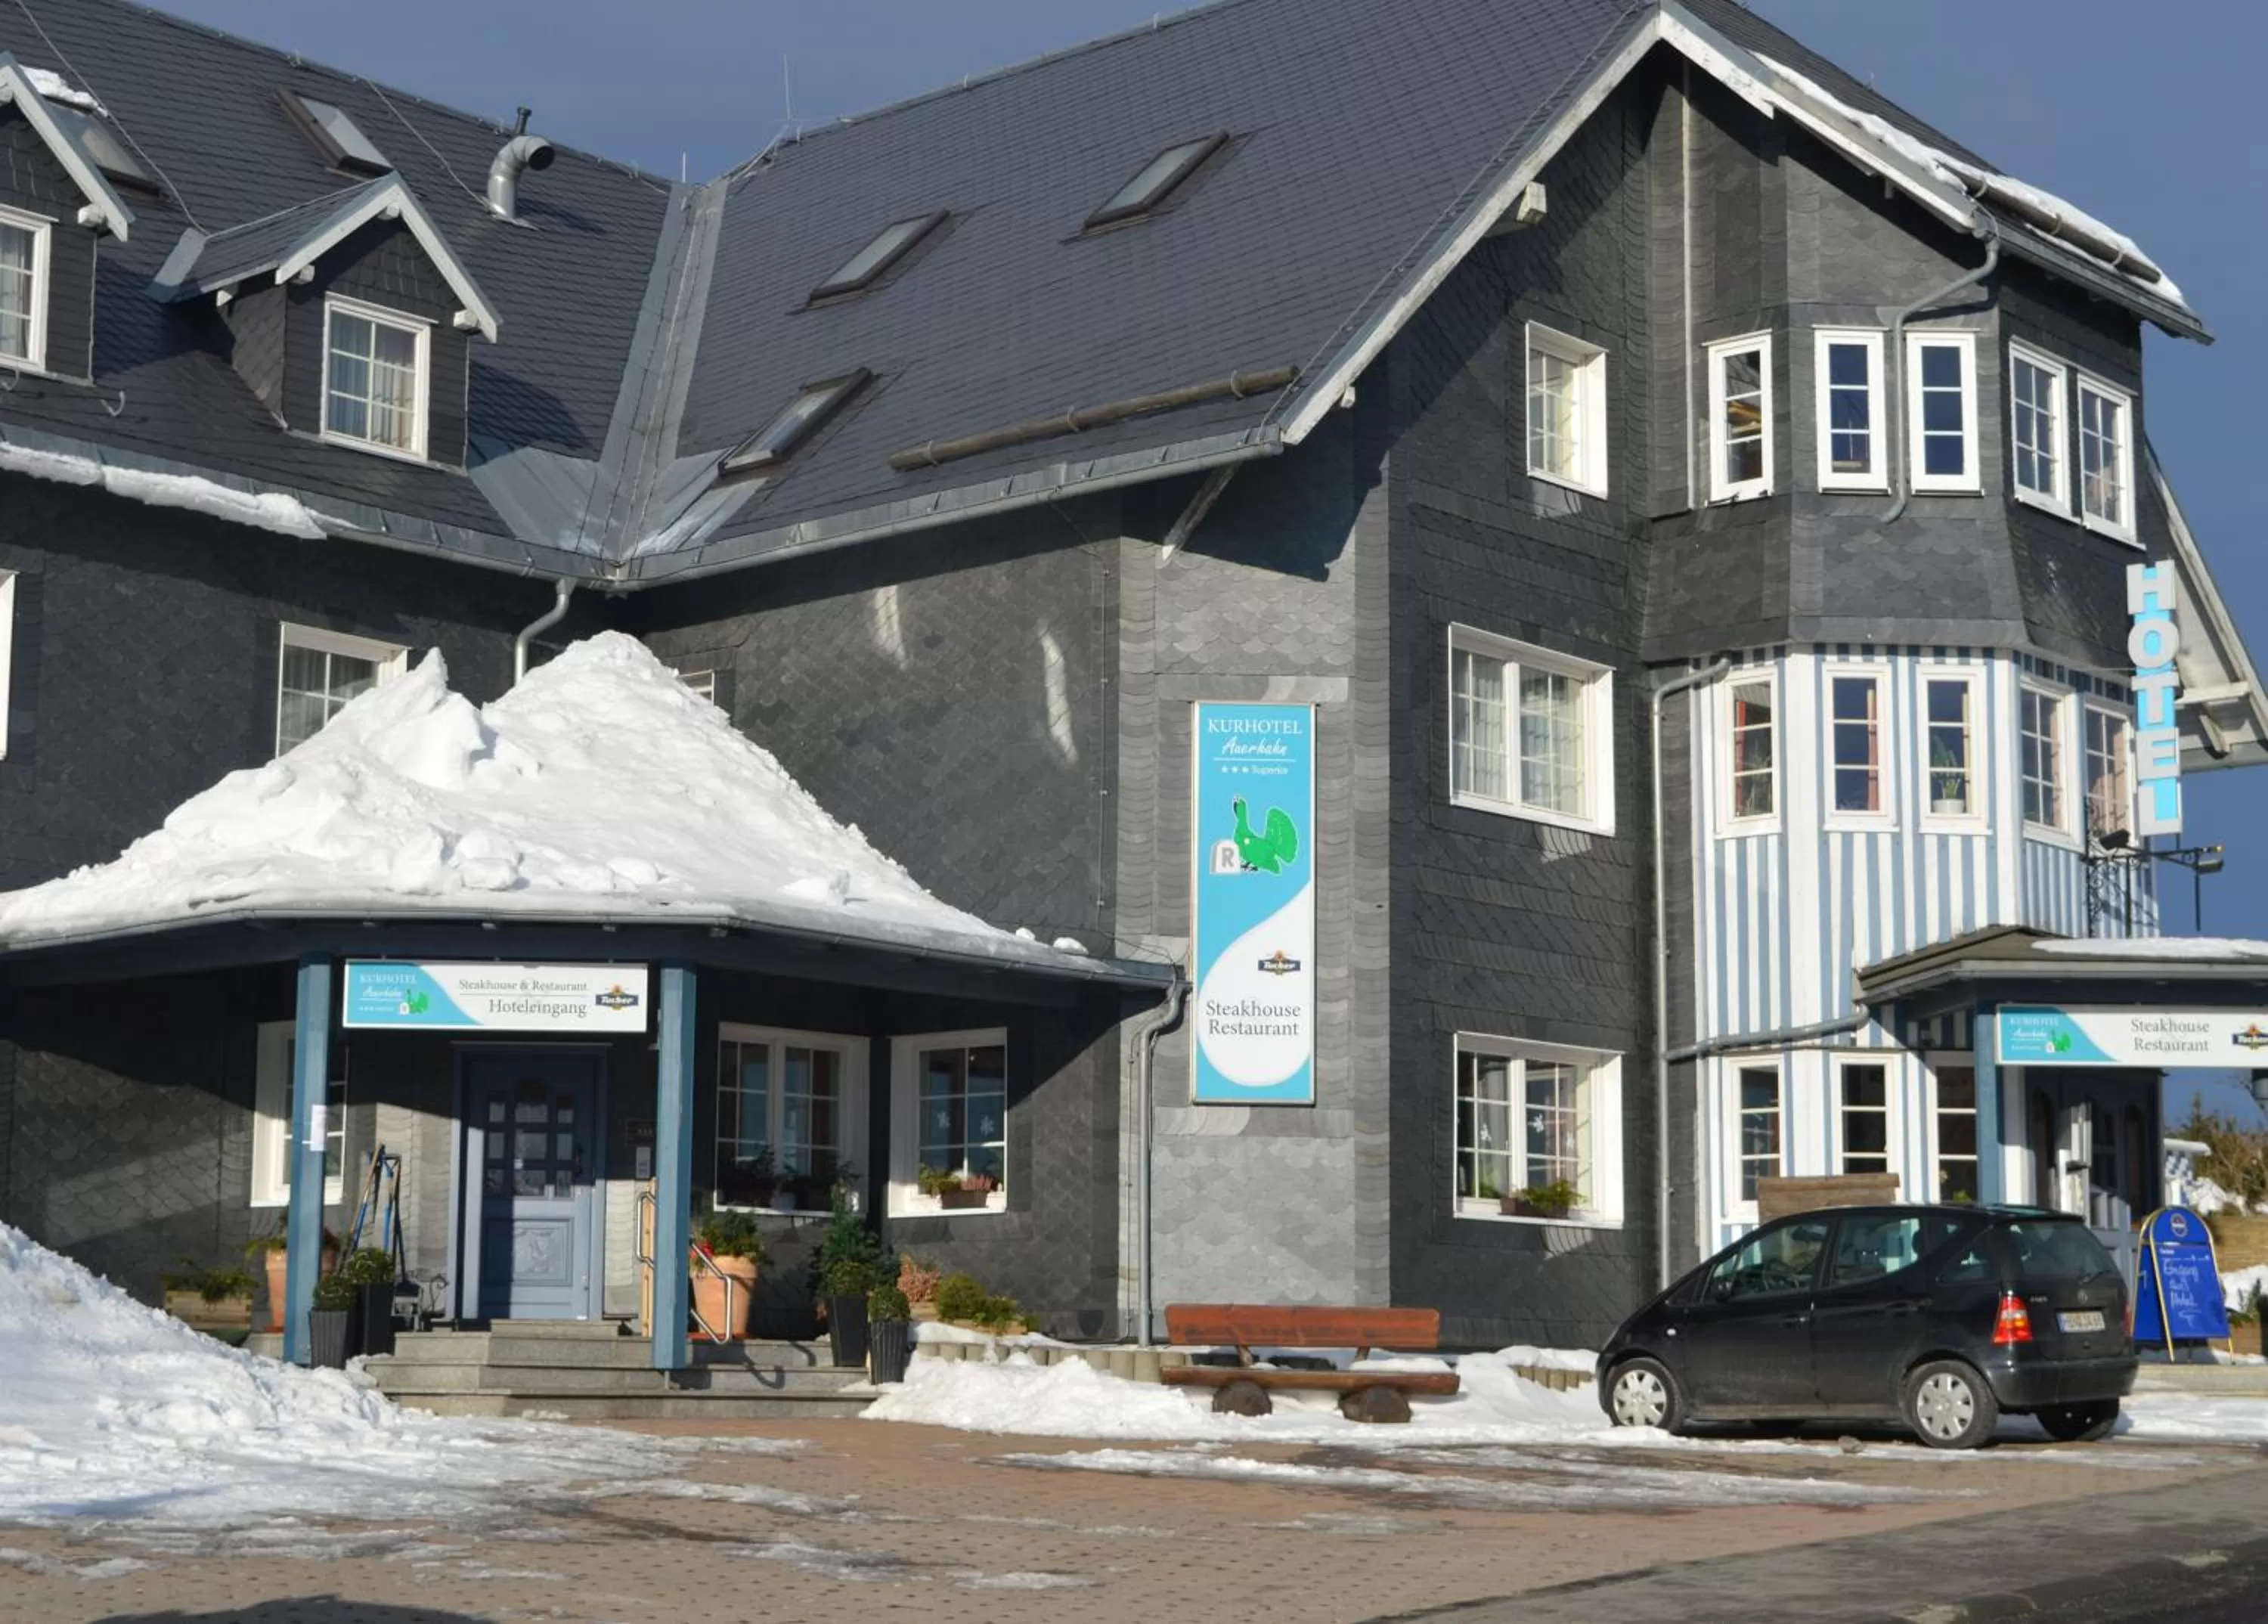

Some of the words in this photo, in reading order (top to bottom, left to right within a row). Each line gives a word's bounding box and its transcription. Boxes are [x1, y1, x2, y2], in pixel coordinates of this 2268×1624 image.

[2127, 560, 2182, 835] HOTEL
[1208, 719, 1303, 734] KURHOTEL
[459, 979, 518, 991] Steakhouse
[531, 981, 587, 992] Restaurant
[488, 998, 587, 1018] Hoteleingang
[1205, 1000, 1301, 1017] Steakhouse
[1209, 1019, 1300, 1036] Restaurant
[2130, 1018, 2210, 1034] Steakhouse
[2134, 1036, 2209, 1052] Restaurant
